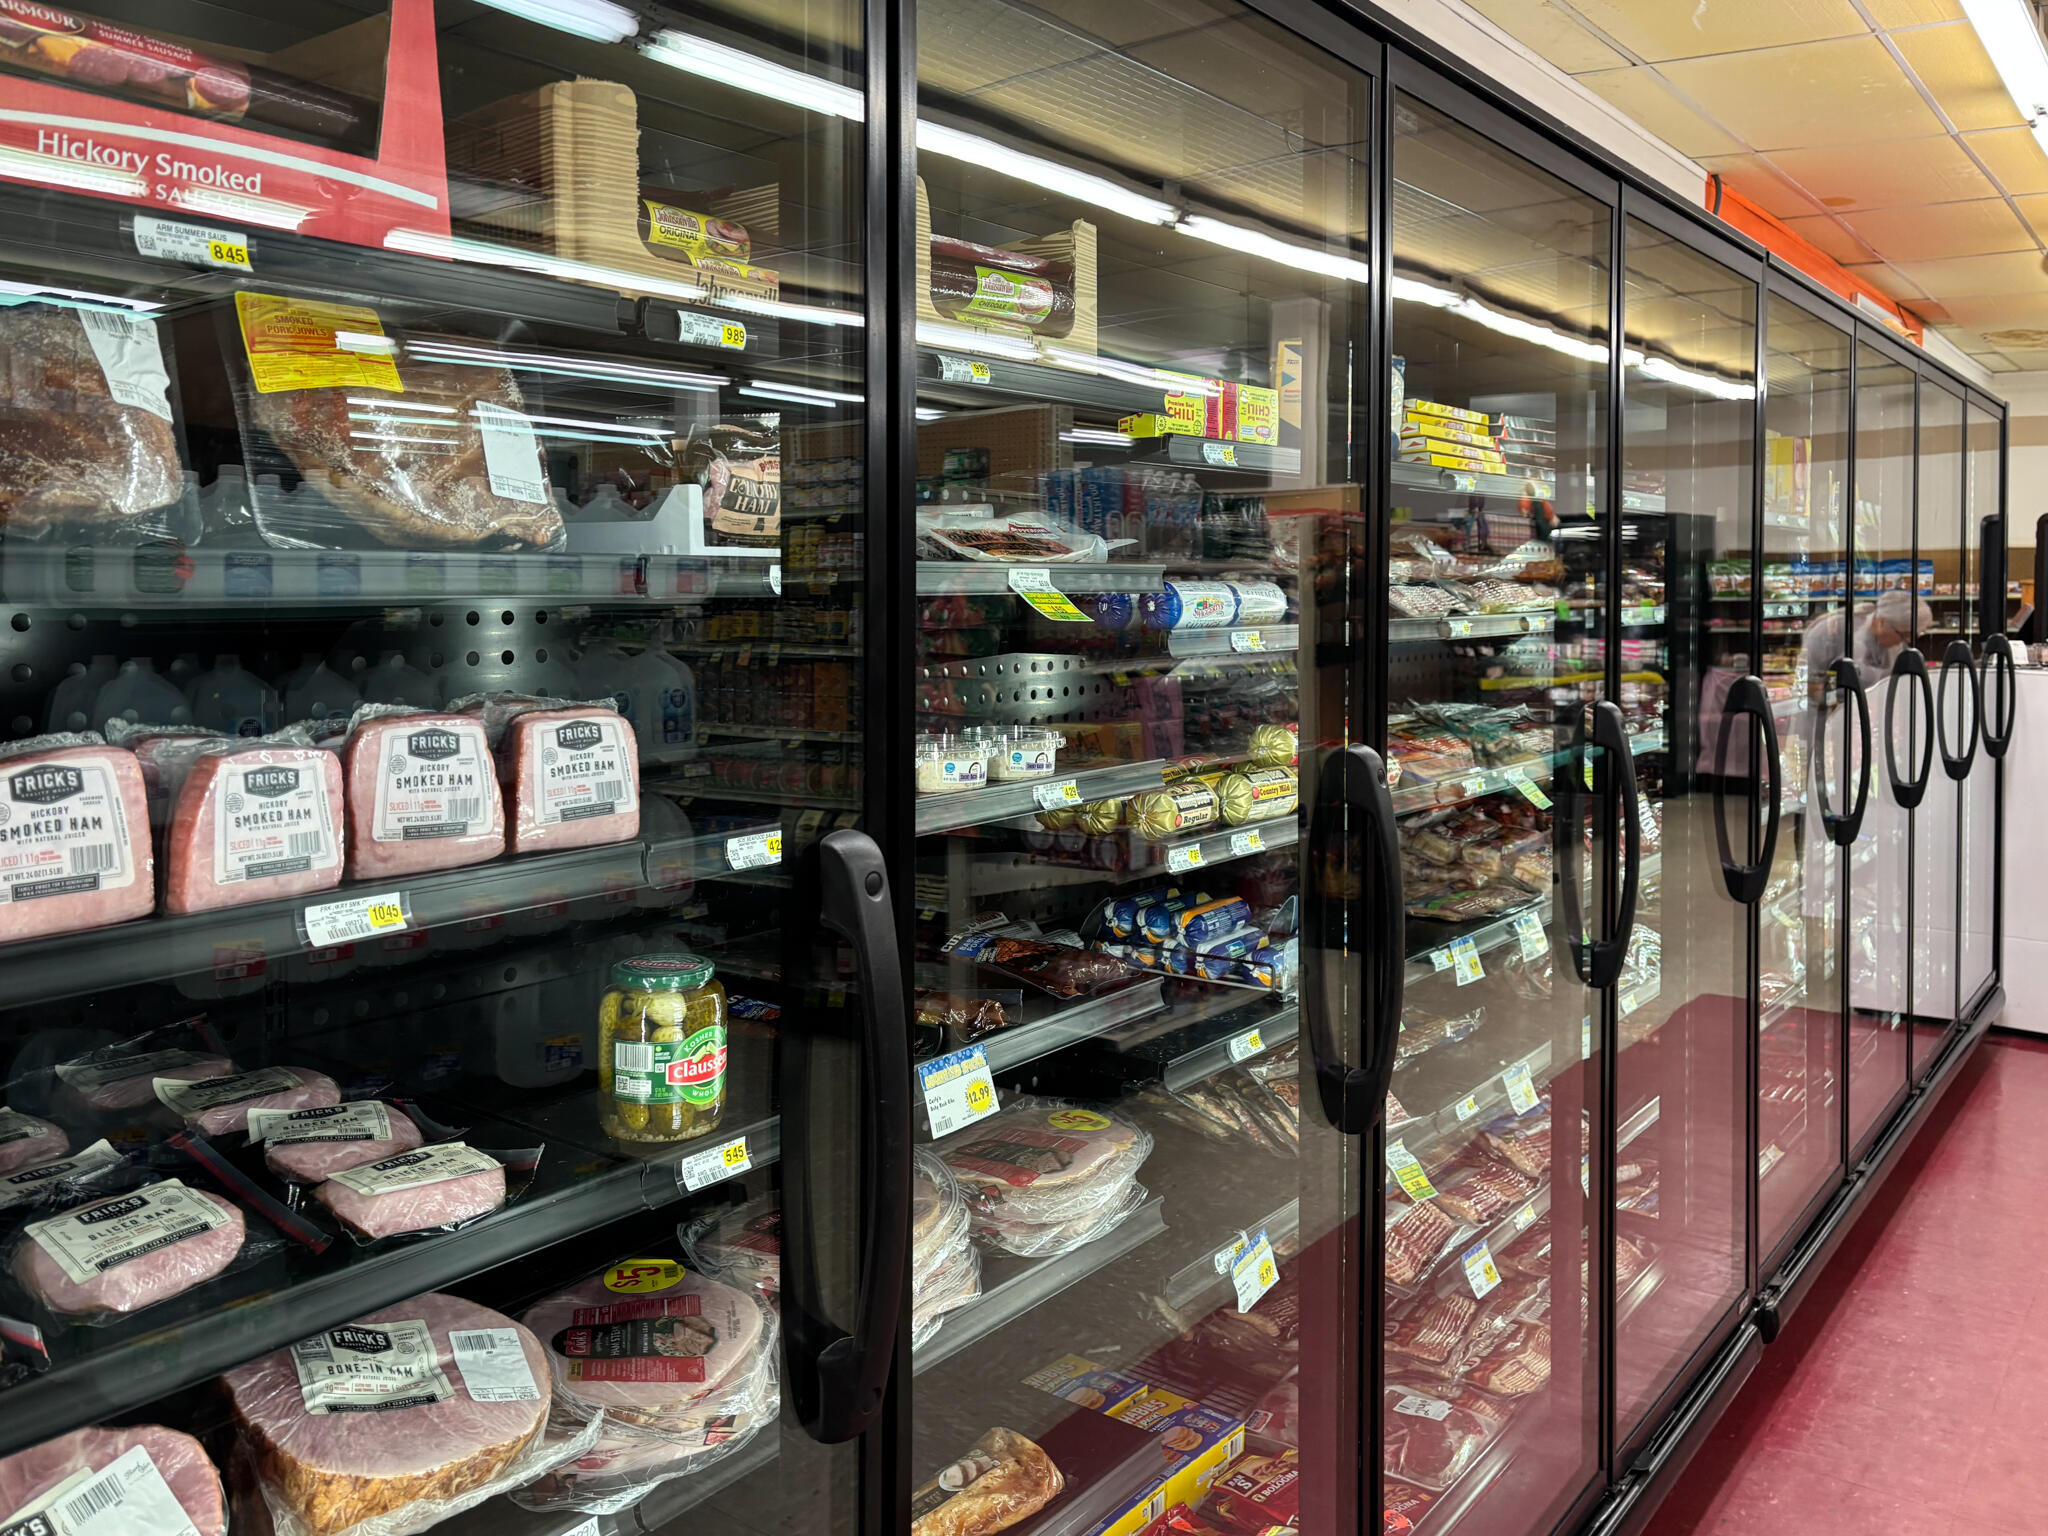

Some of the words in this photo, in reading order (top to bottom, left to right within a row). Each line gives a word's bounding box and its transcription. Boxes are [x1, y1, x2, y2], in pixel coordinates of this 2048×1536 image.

[98, 30, 144, 49] SUMMER
[147, 43, 192, 62] SAUSAGE
[37, 130, 148, 176] Hickory
[156, 153, 262, 194] Smoked
[156, 222, 173, 233] ARM
[174, 225, 206, 238] SUMMER
[207, 231, 227, 242] SAUS
[659, 226, 699, 241] ORIGINAL
[274, 315, 314, 327] SMOKED
[266, 324, 294, 336] PORK
[295, 326, 328, 338] JOWLS
[1167, 407, 1195, 422] CHILI
[729, 477, 778, 499] COUNTRY
[735, 496, 771, 514] HAM
[411, 735, 457, 750] FRICK'S
[560, 726, 599, 742] FRICK'S
[420, 764, 450, 773] HICKORY
[550, 762, 590, 778] SMOKED
[594, 760, 615, 770] HAM
[14, 770, 79, 795] FRICK'S
[247, 770, 296, 789] FRICK'S
[396, 775, 443, 790] SMOKED
[448, 774, 473, 785] HAM
[1280, 784, 1291, 794] Mild
[30, 805, 70, 820] HICKORY
[259, 800, 288, 810] HICKORY
[234, 811, 283, 828] SMOKED
[288, 808, 312, 820] HAM
[1183, 812, 1208, 824] Regular
[0, 819, 63, 842] SMOKED
[70, 816, 103, 831] HAM
[684, 1031, 713, 1053] KOSHER
[968, 1085, 990, 1106] 12.99
[282, 1120, 327, 1131] SLICED
[726, 1145, 745, 1162] 545
[384, 1165, 427, 1180] SLICED
[431, 1158, 457, 1168] HAM
[81, 1197, 144, 1223] FRICK'S
[88, 1219, 138, 1241] SLICED
[144, 1208, 176, 1221] HAM
[610, 1266, 662, 1288] $5
[332, 1330, 386, 1346] FRICK'S
[327, 1363, 383, 1376] BONE-IN
[1228, 1474, 1245, 1488] BAR
[1237, 1478, 1253, 1491] S
[1260, 1469, 1299, 1498] BOLOGNA
